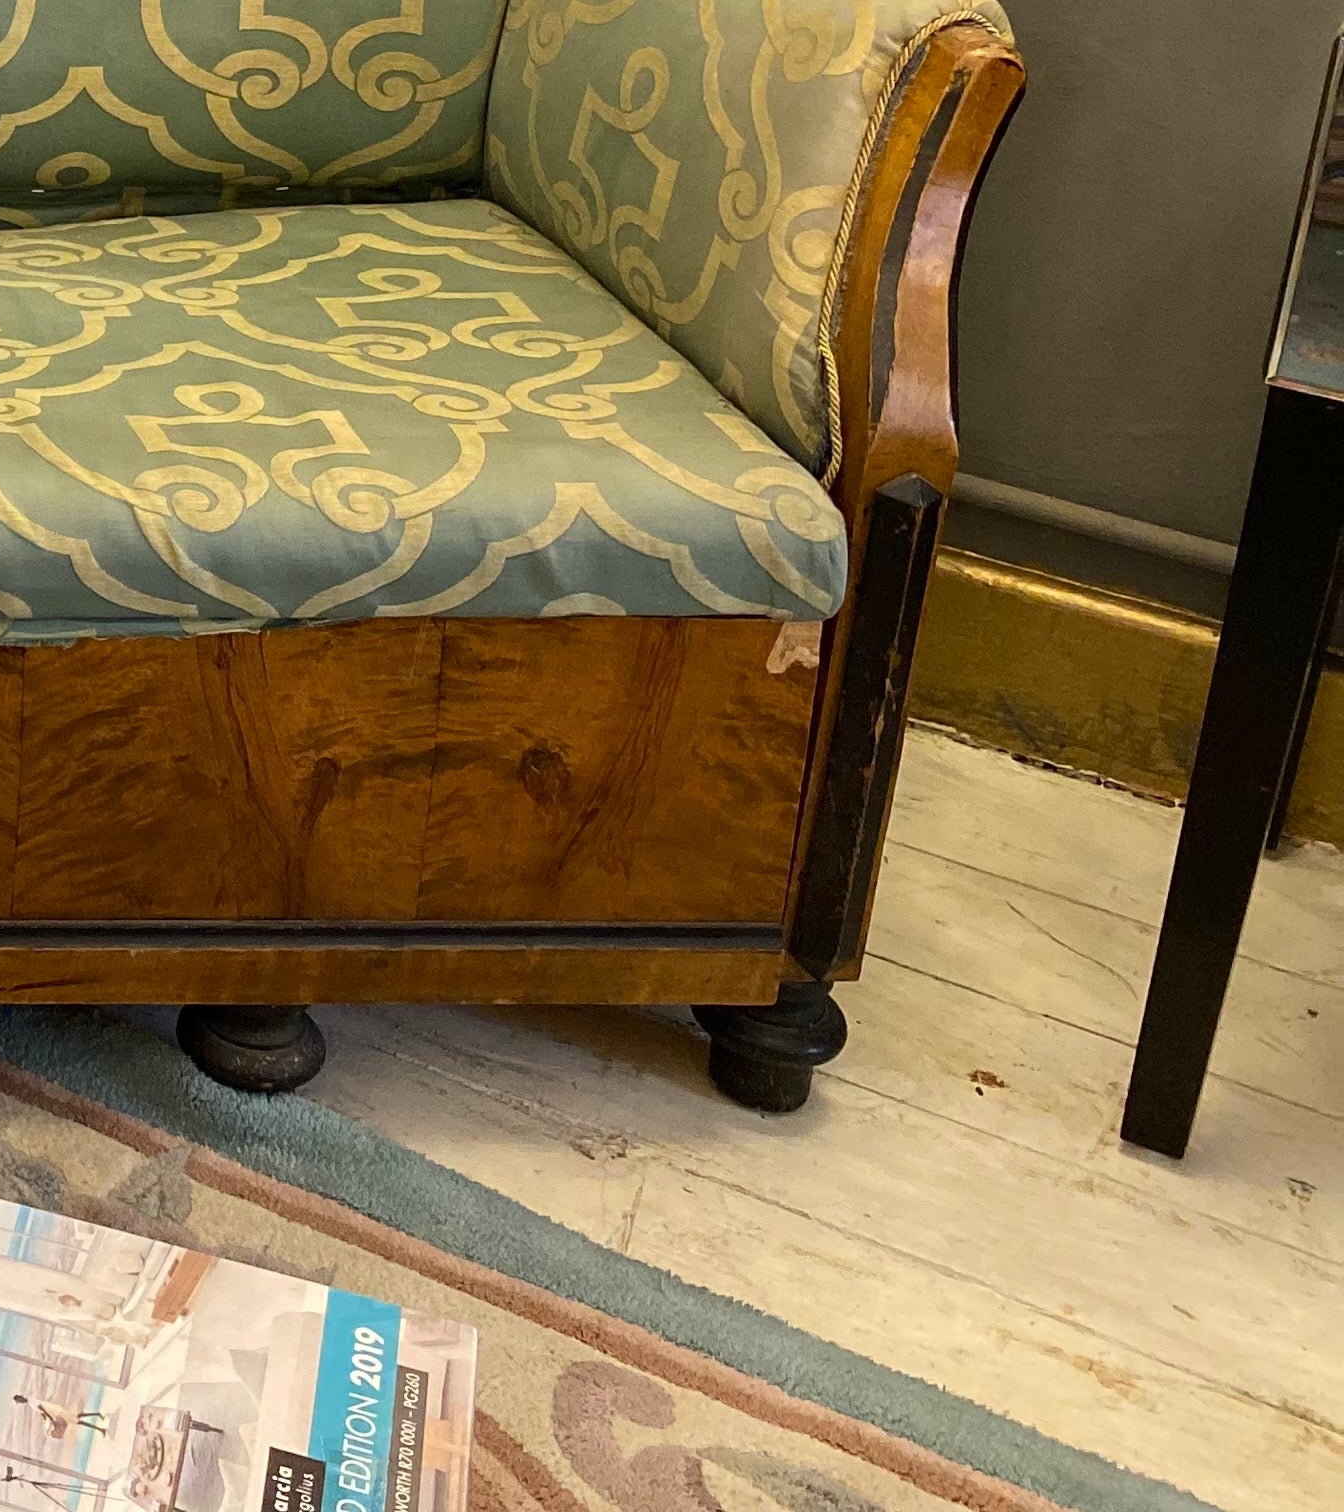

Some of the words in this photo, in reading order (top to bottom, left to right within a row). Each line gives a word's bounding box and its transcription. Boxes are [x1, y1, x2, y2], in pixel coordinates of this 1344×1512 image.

[348, 1326, 385, 1392] 2019
[403, 1372, 421, 1409] PG260
[339, 1391, 380, 1495] EDITION
[398, 1447, 415, 1469] R70
[296, 1473, 315, 1512] golius
